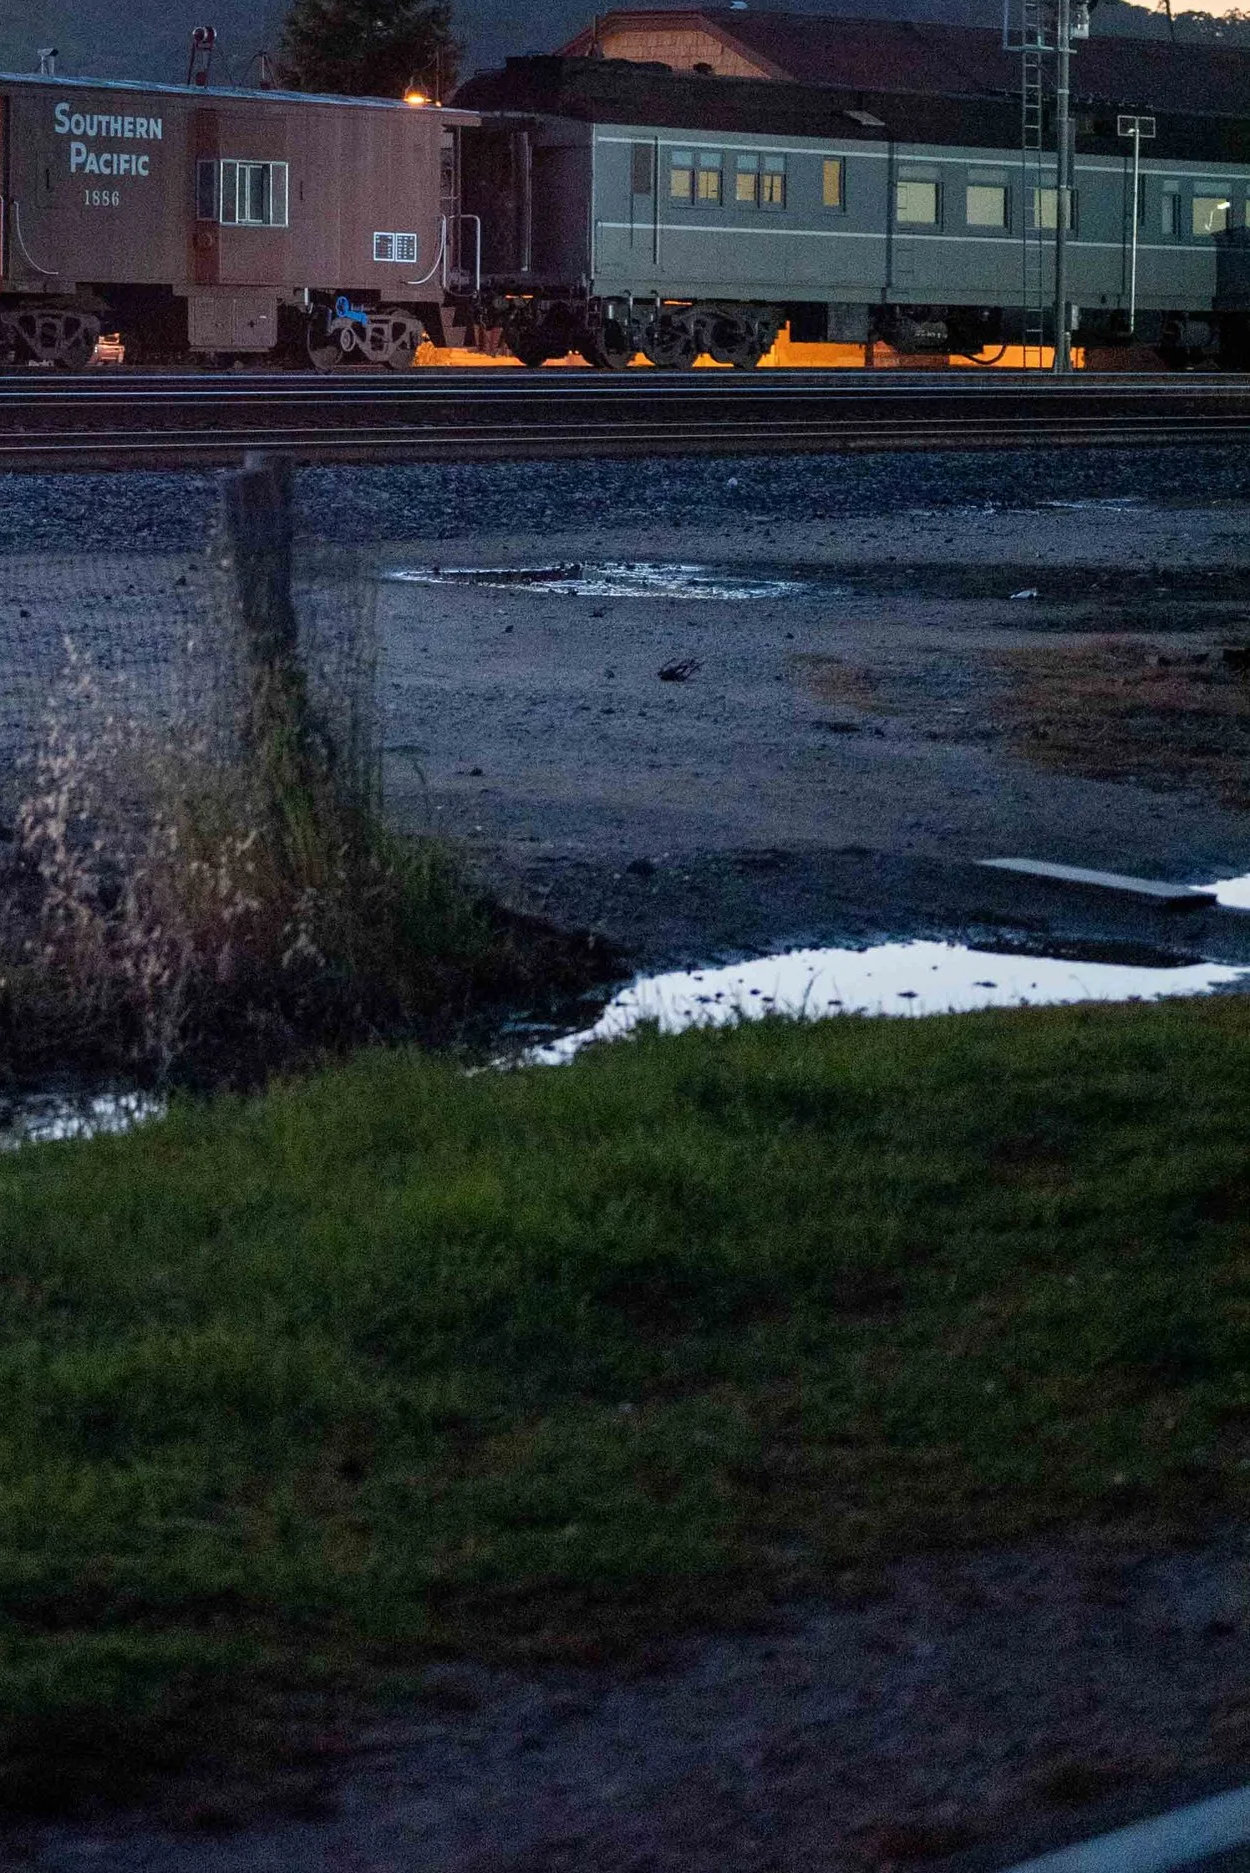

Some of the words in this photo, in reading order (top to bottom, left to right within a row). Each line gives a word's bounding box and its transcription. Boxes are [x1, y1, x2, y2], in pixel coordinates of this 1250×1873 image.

[54, 102, 163, 140] SOUTHERN
[70, 141, 150, 176] PACIFIC
[84, 189, 120, 206] 1886
